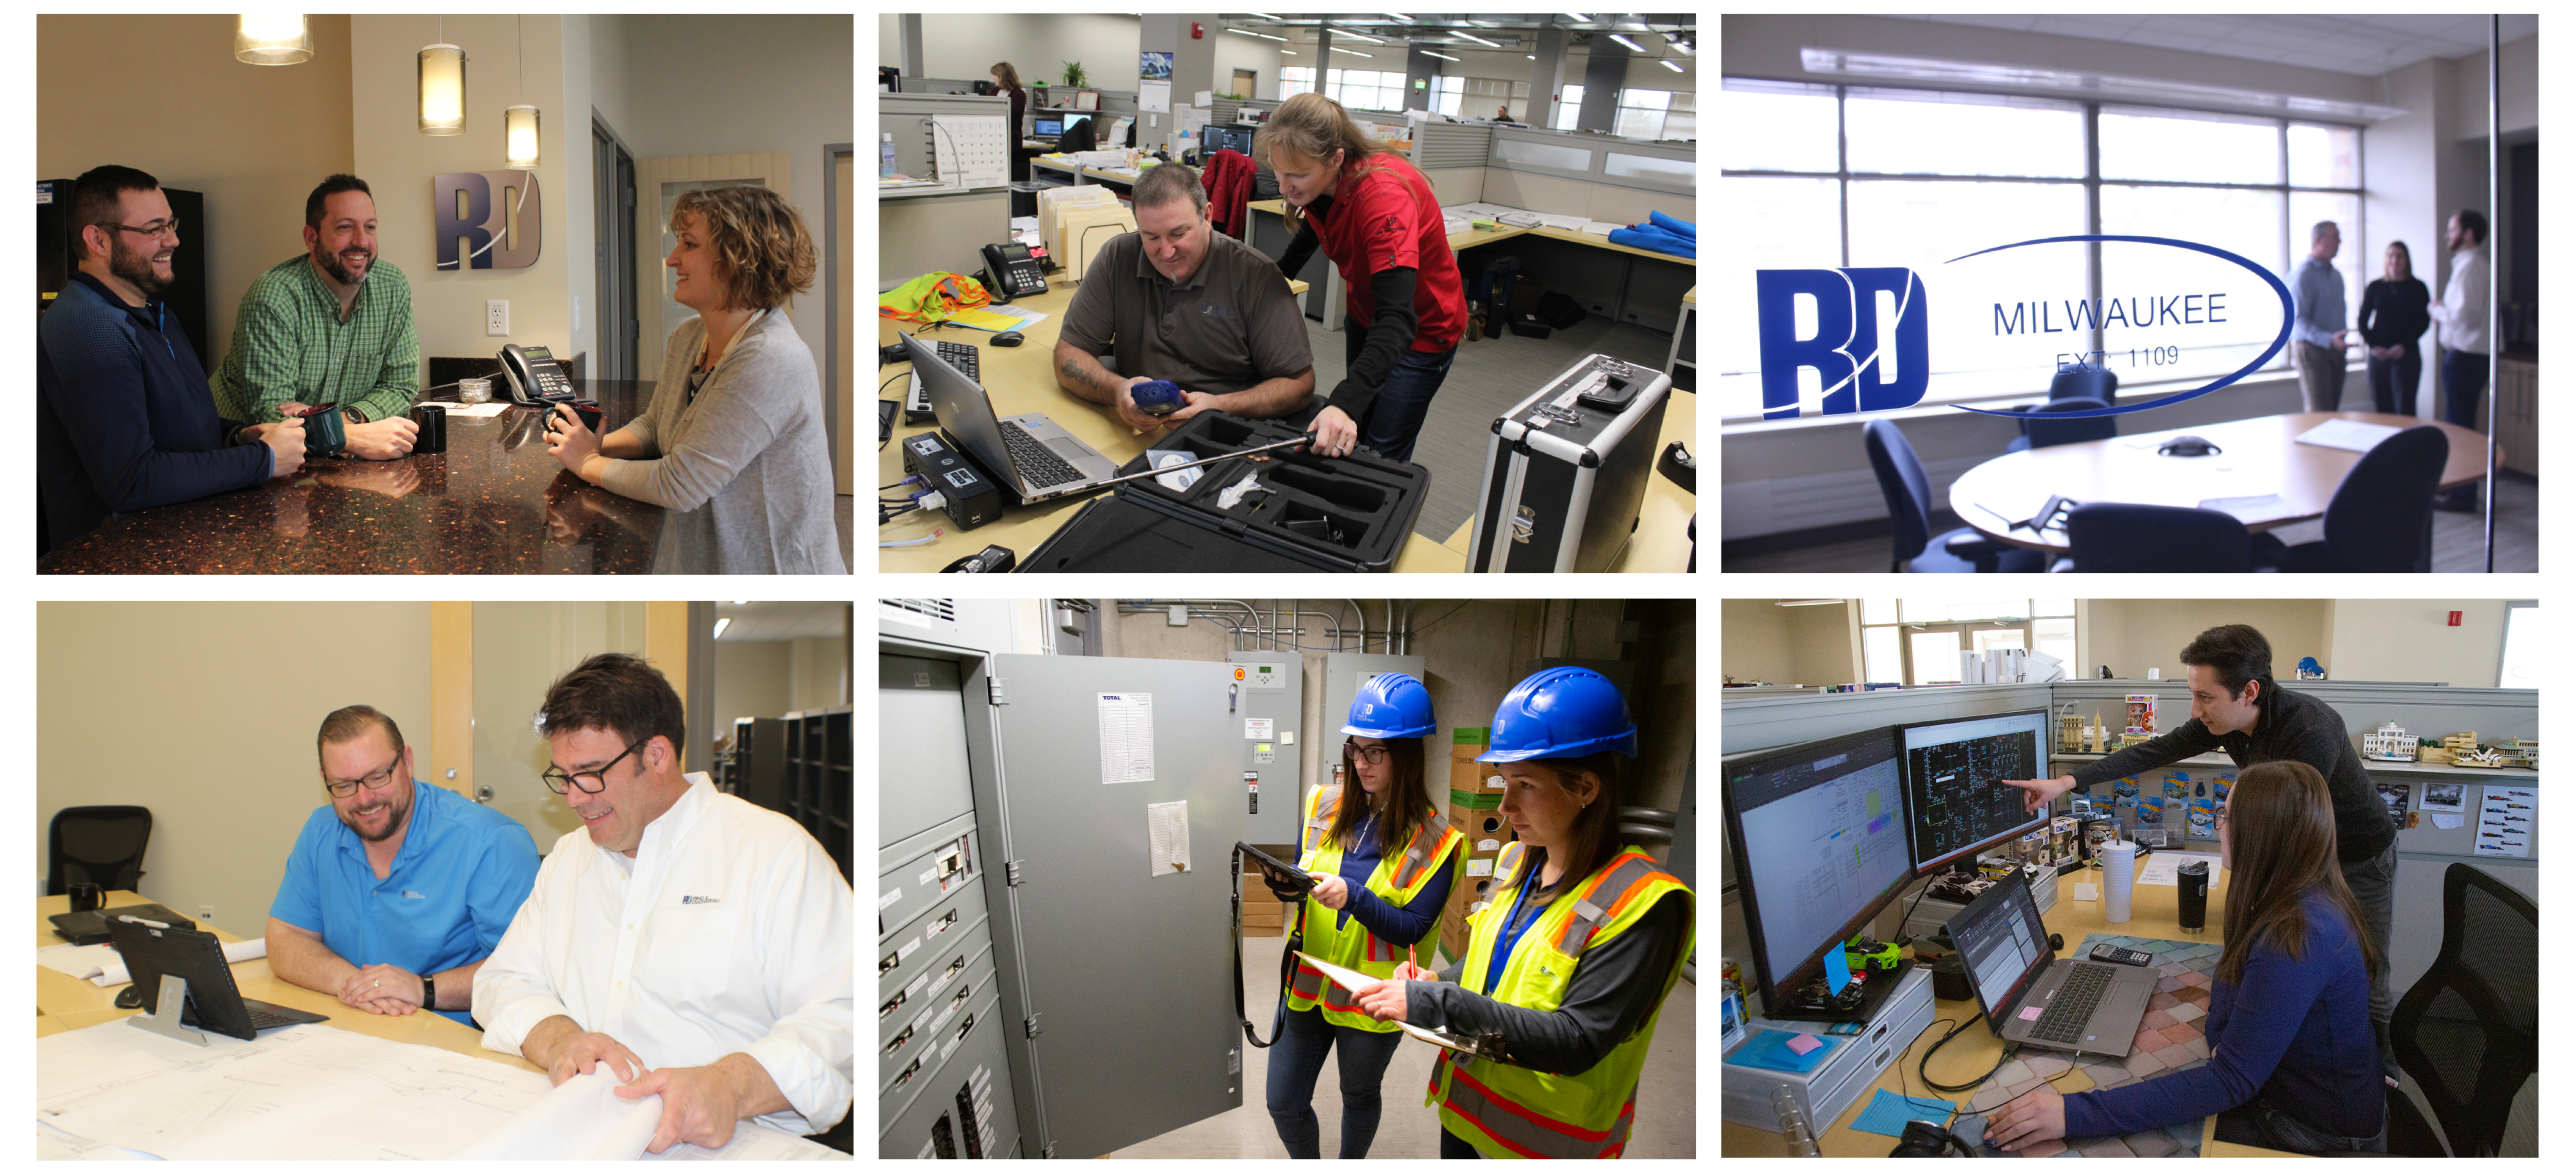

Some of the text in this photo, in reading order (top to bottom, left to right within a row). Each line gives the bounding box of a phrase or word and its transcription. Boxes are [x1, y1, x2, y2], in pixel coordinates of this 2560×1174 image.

[434, 169, 542, 271] RD
[1756, 267, 1930, 421] RD
[1993, 293, 2228, 337] MILWAUKEE
[2056, 345, 2179, 375] EXT: 1109
